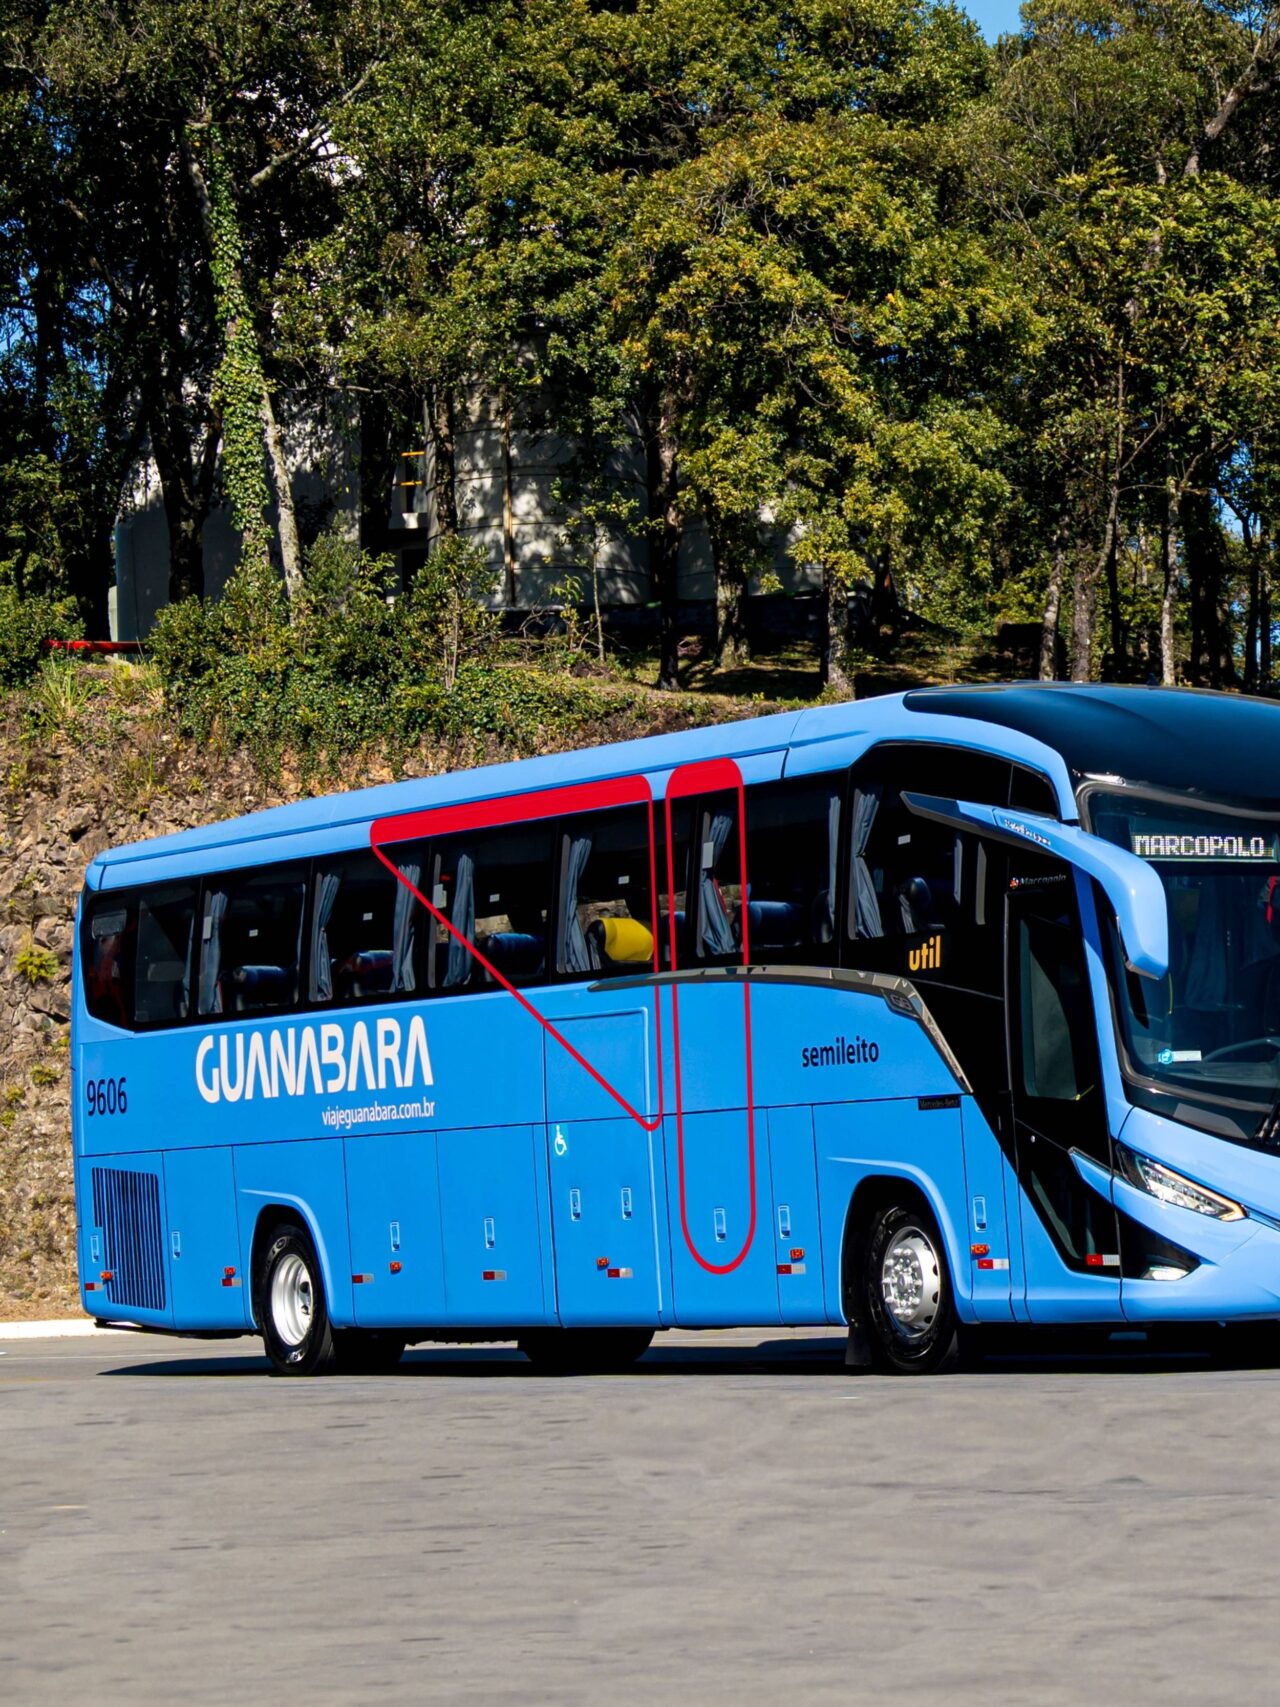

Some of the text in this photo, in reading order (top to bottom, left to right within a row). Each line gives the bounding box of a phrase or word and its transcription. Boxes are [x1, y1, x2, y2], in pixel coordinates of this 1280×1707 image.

[1134, 835, 1265, 857] MARCOPOLO
[909, 935, 941, 971] util
[195, 1014, 434, 1104] GUANABARA
[801, 1034, 880, 1068] semileito
[86, 1076, 128, 1117] 9606
[321, 1096, 436, 1130] viajeguanabara.com.br
